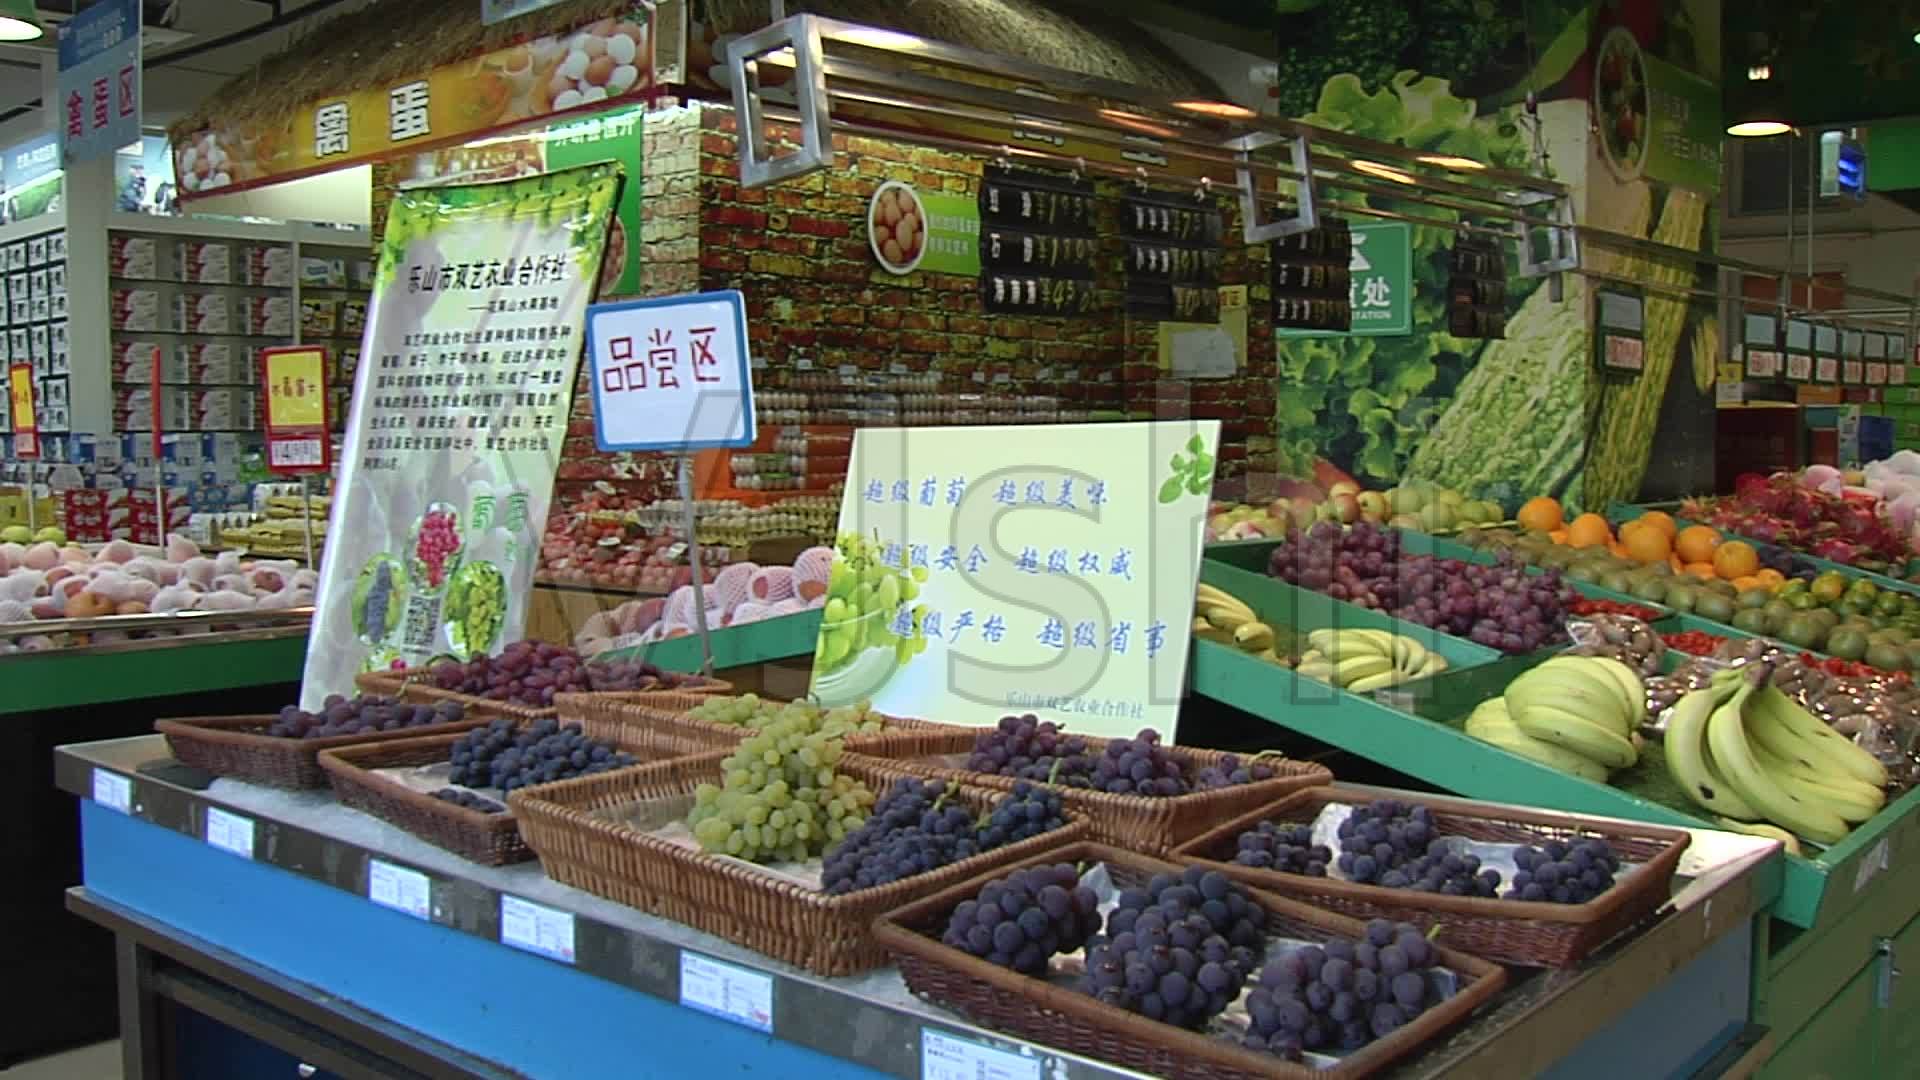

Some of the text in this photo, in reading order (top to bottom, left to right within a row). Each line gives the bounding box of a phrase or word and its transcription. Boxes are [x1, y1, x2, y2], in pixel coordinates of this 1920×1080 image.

[407, 253, 567, 294] 乐山市双艺农业合作社
[602, 327, 721, 393] 品尝区
[862, 476, 1108, 509] 超级葡萄 超级美味
[879, 543, 1136, 581] 超级安全 超级权威
[886, 609, 1168, 660] 超级严格 超级省事
